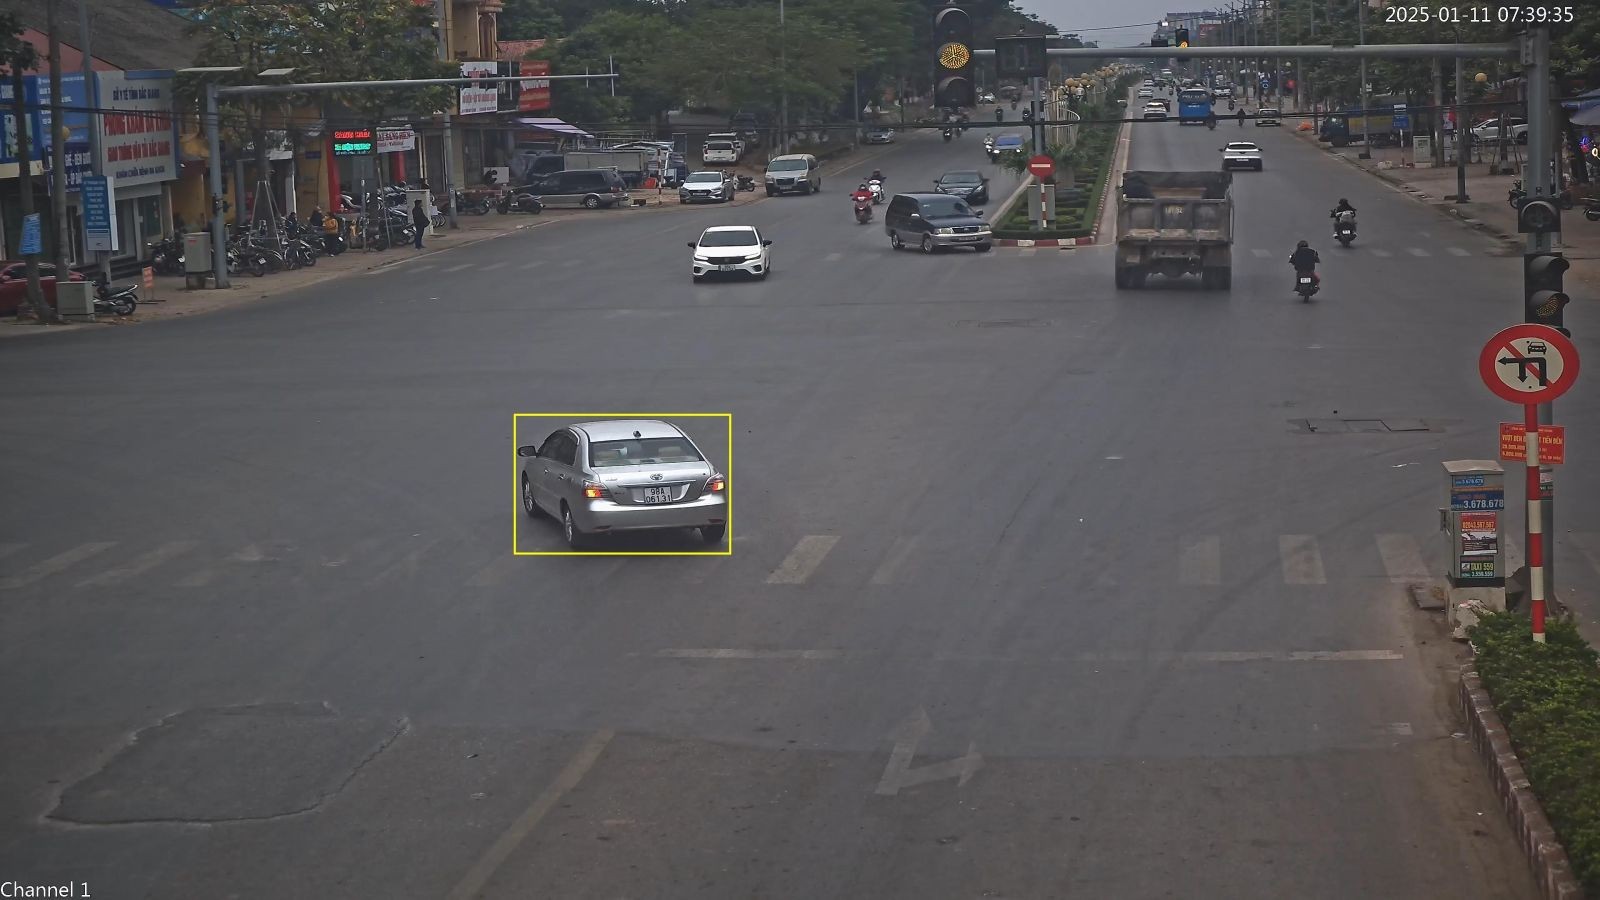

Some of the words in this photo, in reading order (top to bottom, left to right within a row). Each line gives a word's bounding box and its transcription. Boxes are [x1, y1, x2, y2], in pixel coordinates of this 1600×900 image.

[1463, 499, 1504, 509] 3.678.678
[1470, 562, 1483, 571] TAXI
[1483, 562, 1494, 571] 559
